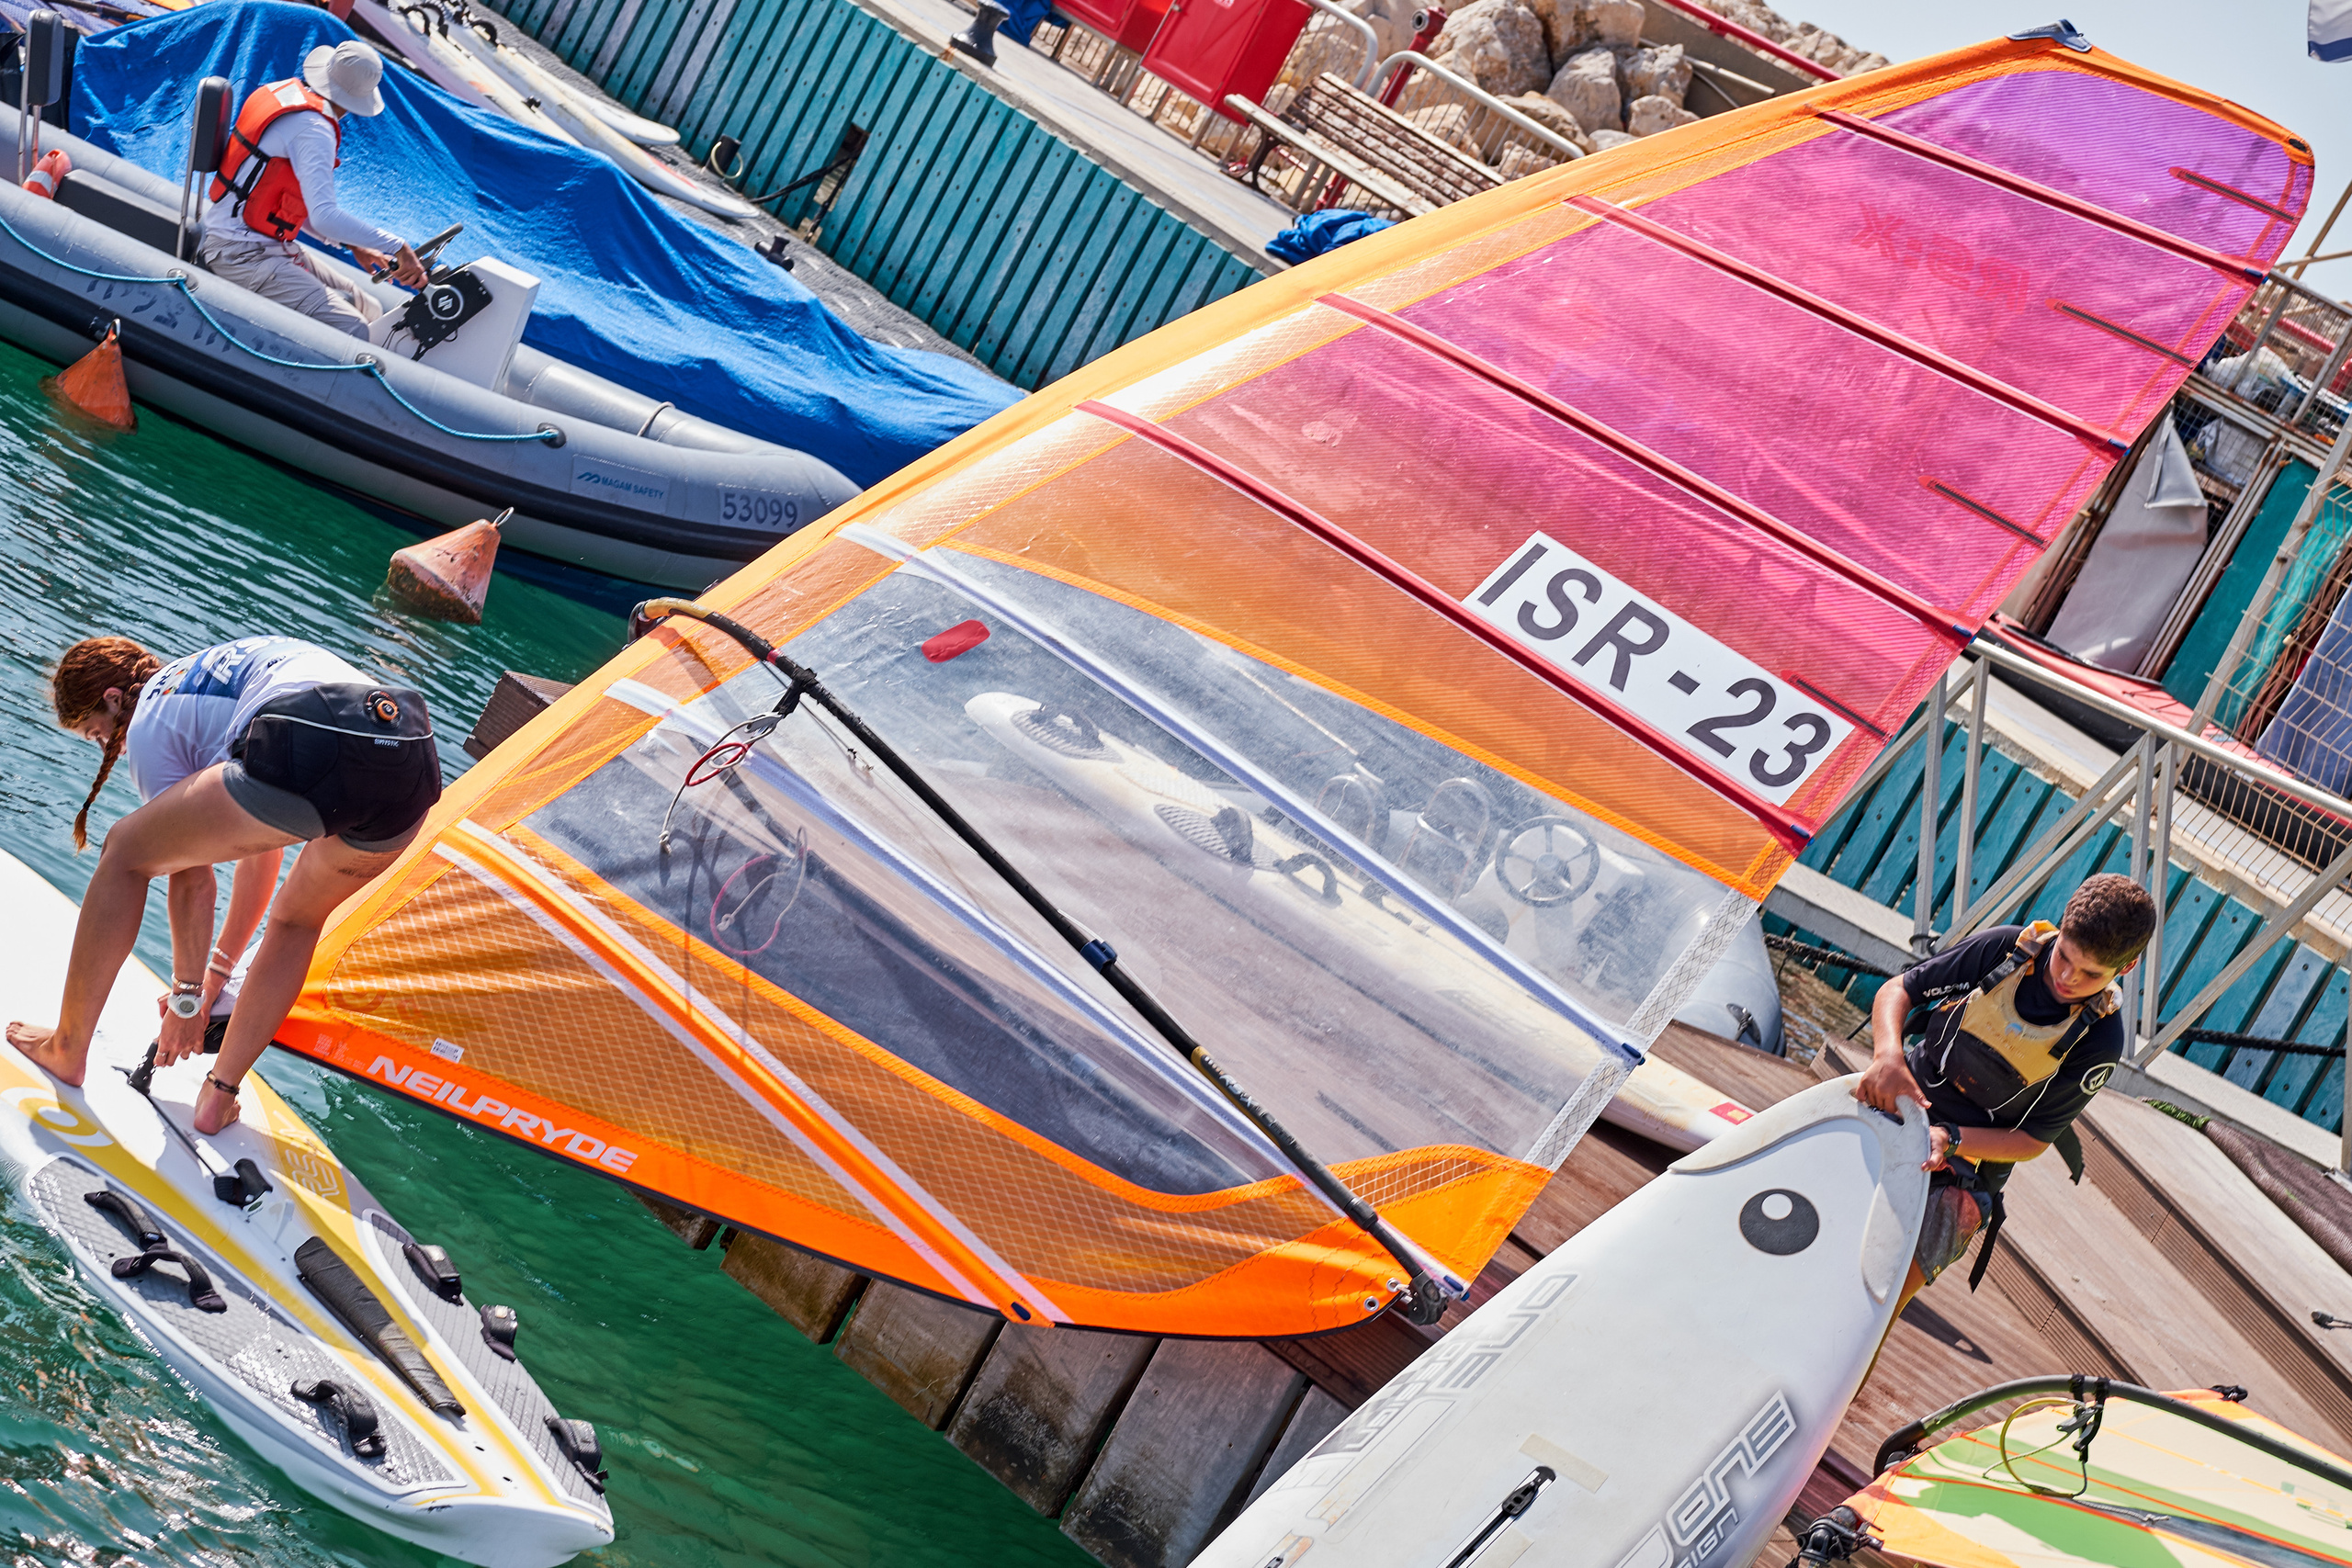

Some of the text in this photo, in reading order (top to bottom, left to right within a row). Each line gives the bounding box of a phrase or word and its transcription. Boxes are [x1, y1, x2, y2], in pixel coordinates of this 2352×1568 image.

[601, 476, 664, 500] MAGAM SAFETY
[722, 492, 798, 528] 53099
[1477, 543, 1831, 787] ISR-23
[367, 1055, 639, 1173] NEILPRYDE
[1665, 1388, 1798, 1548] ONE
